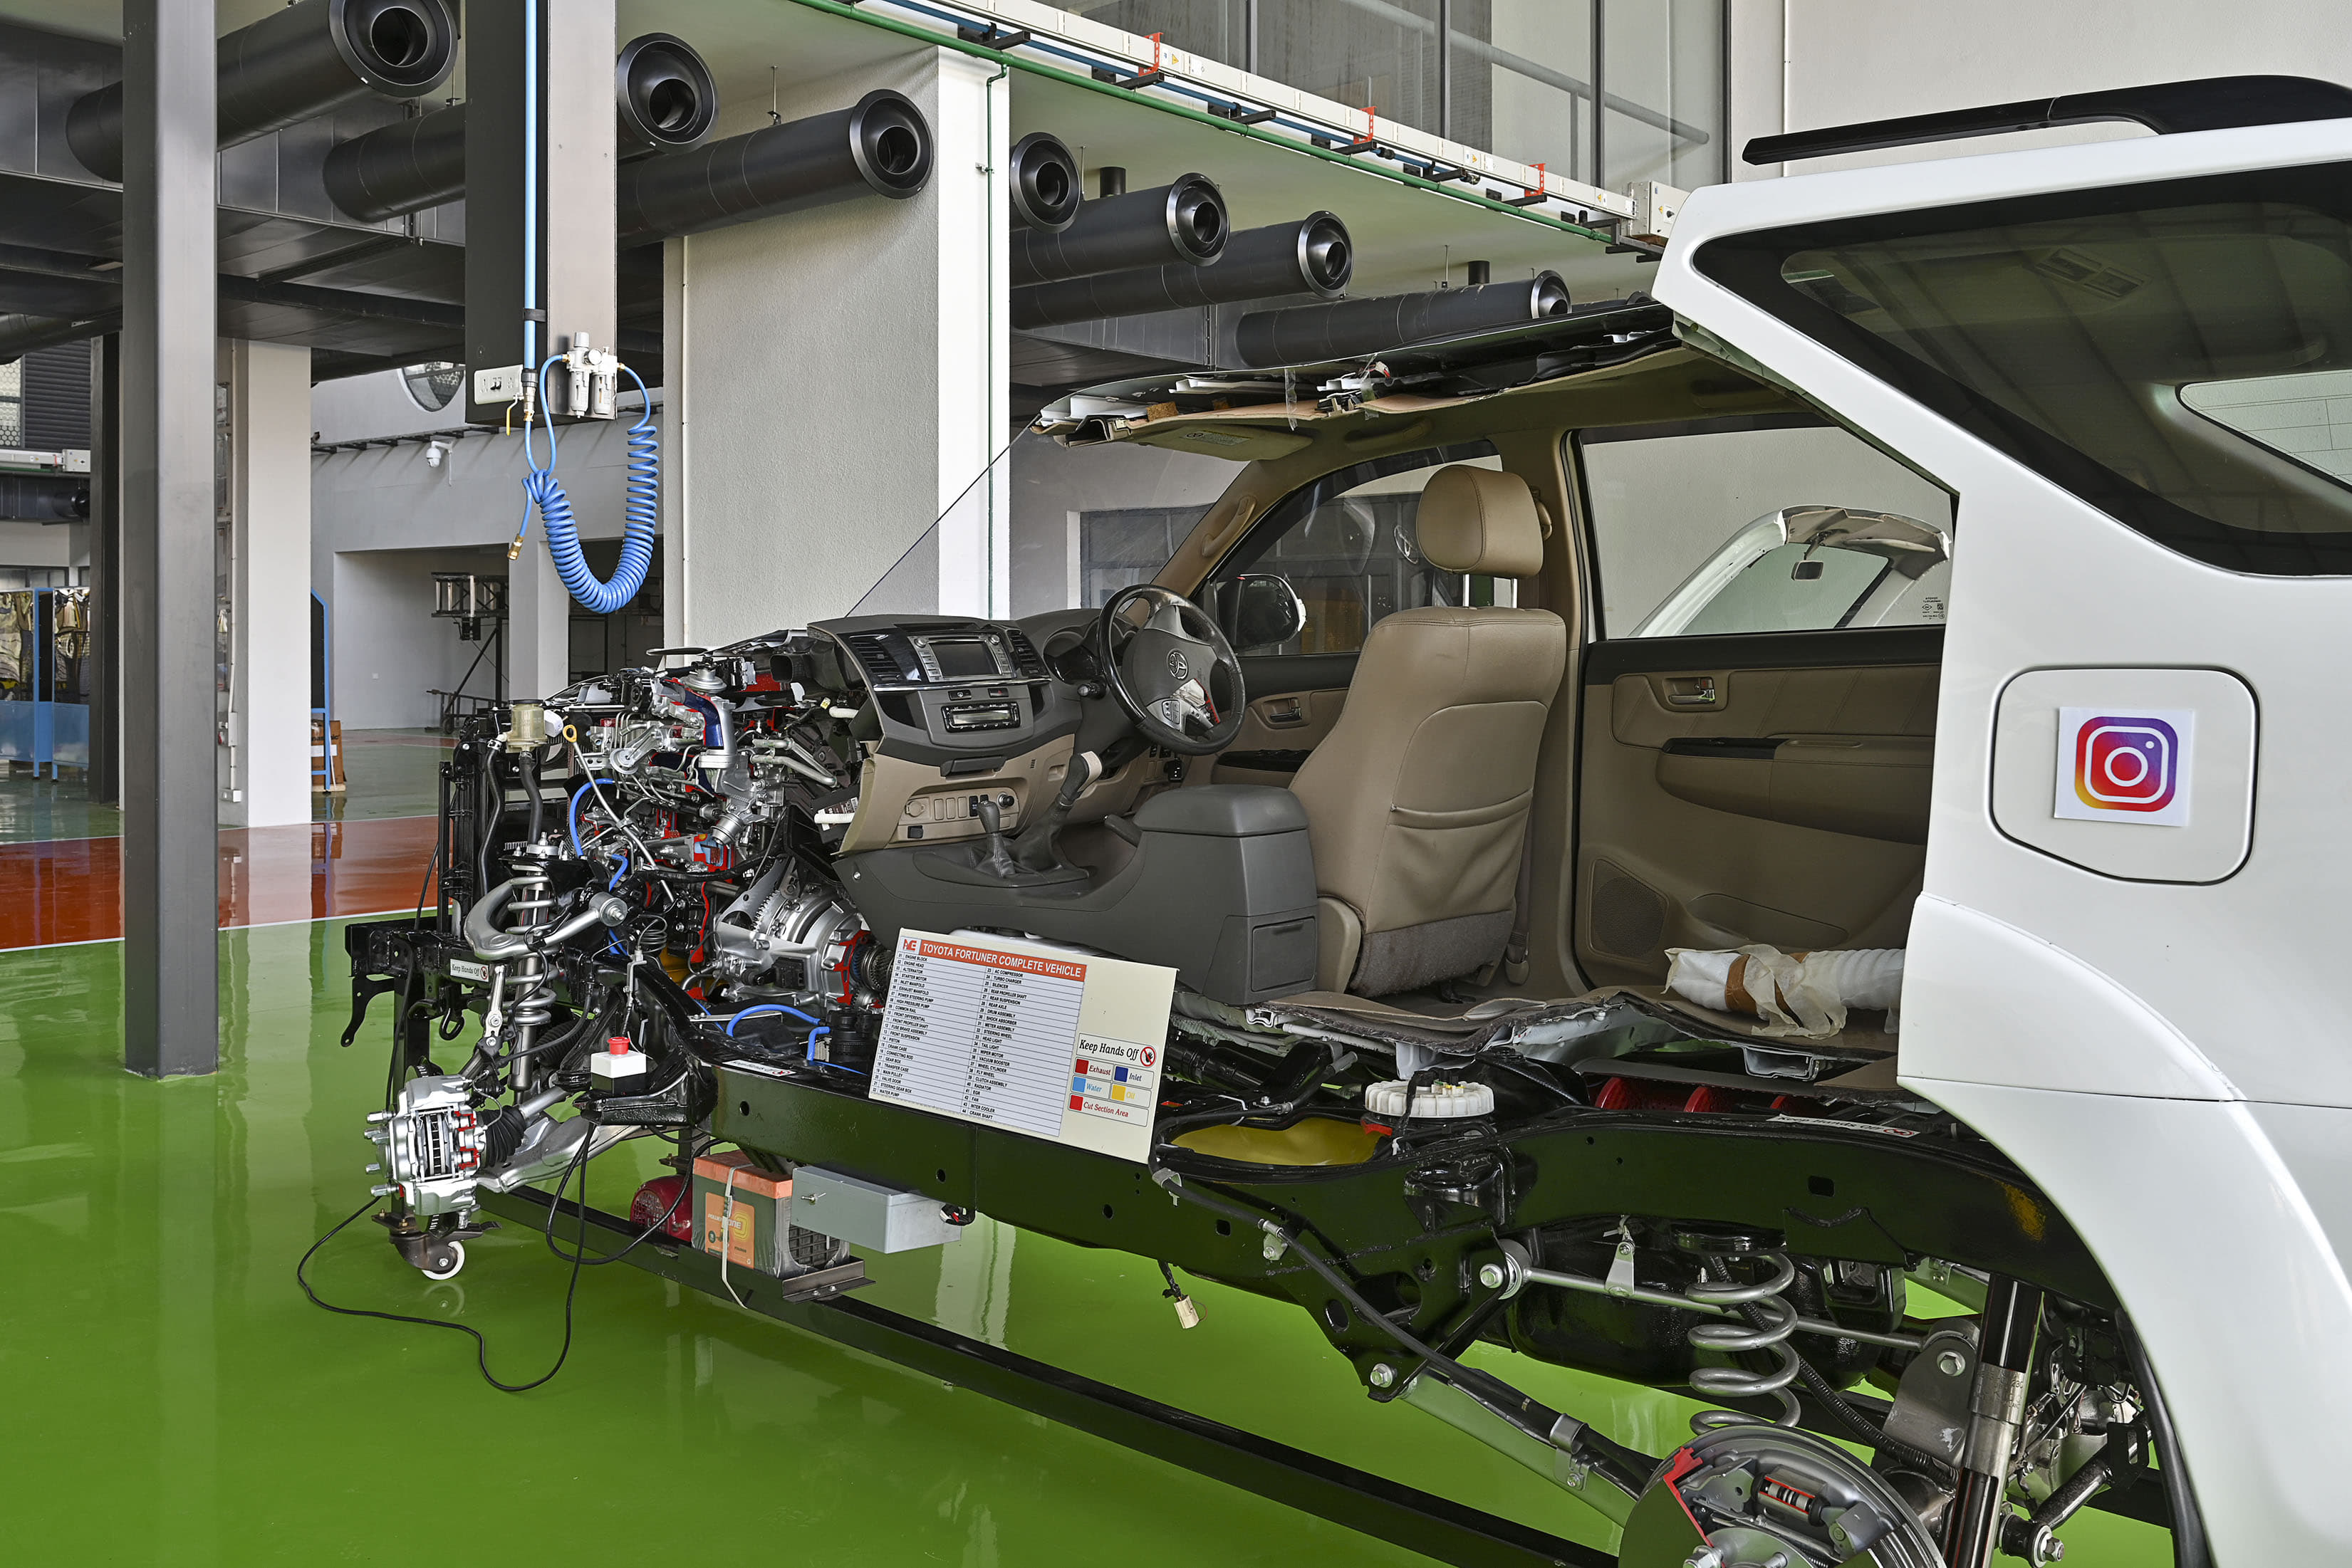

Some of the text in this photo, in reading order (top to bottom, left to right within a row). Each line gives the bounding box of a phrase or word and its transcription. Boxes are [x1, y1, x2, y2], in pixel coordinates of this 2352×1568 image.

[922, 944, 954, 956] TOYOTA
[954, 948, 997, 963] FORTUNER
[998, 956, 1044, 971] COMPLETE
[1044, 963, 1081, 977] VEHICLE
[1079, 1040, 1139, 1060] Keep Hands Off
[1089, 1065, 1110, 1075] Exhaust
[1086, 1083, 1102, 1092] Water
[1094, 1104, 1114, 1114] Section
[1811, 1119, 1856, 1128] Hands
[707, 1213, 741, 1229] POWERONE
